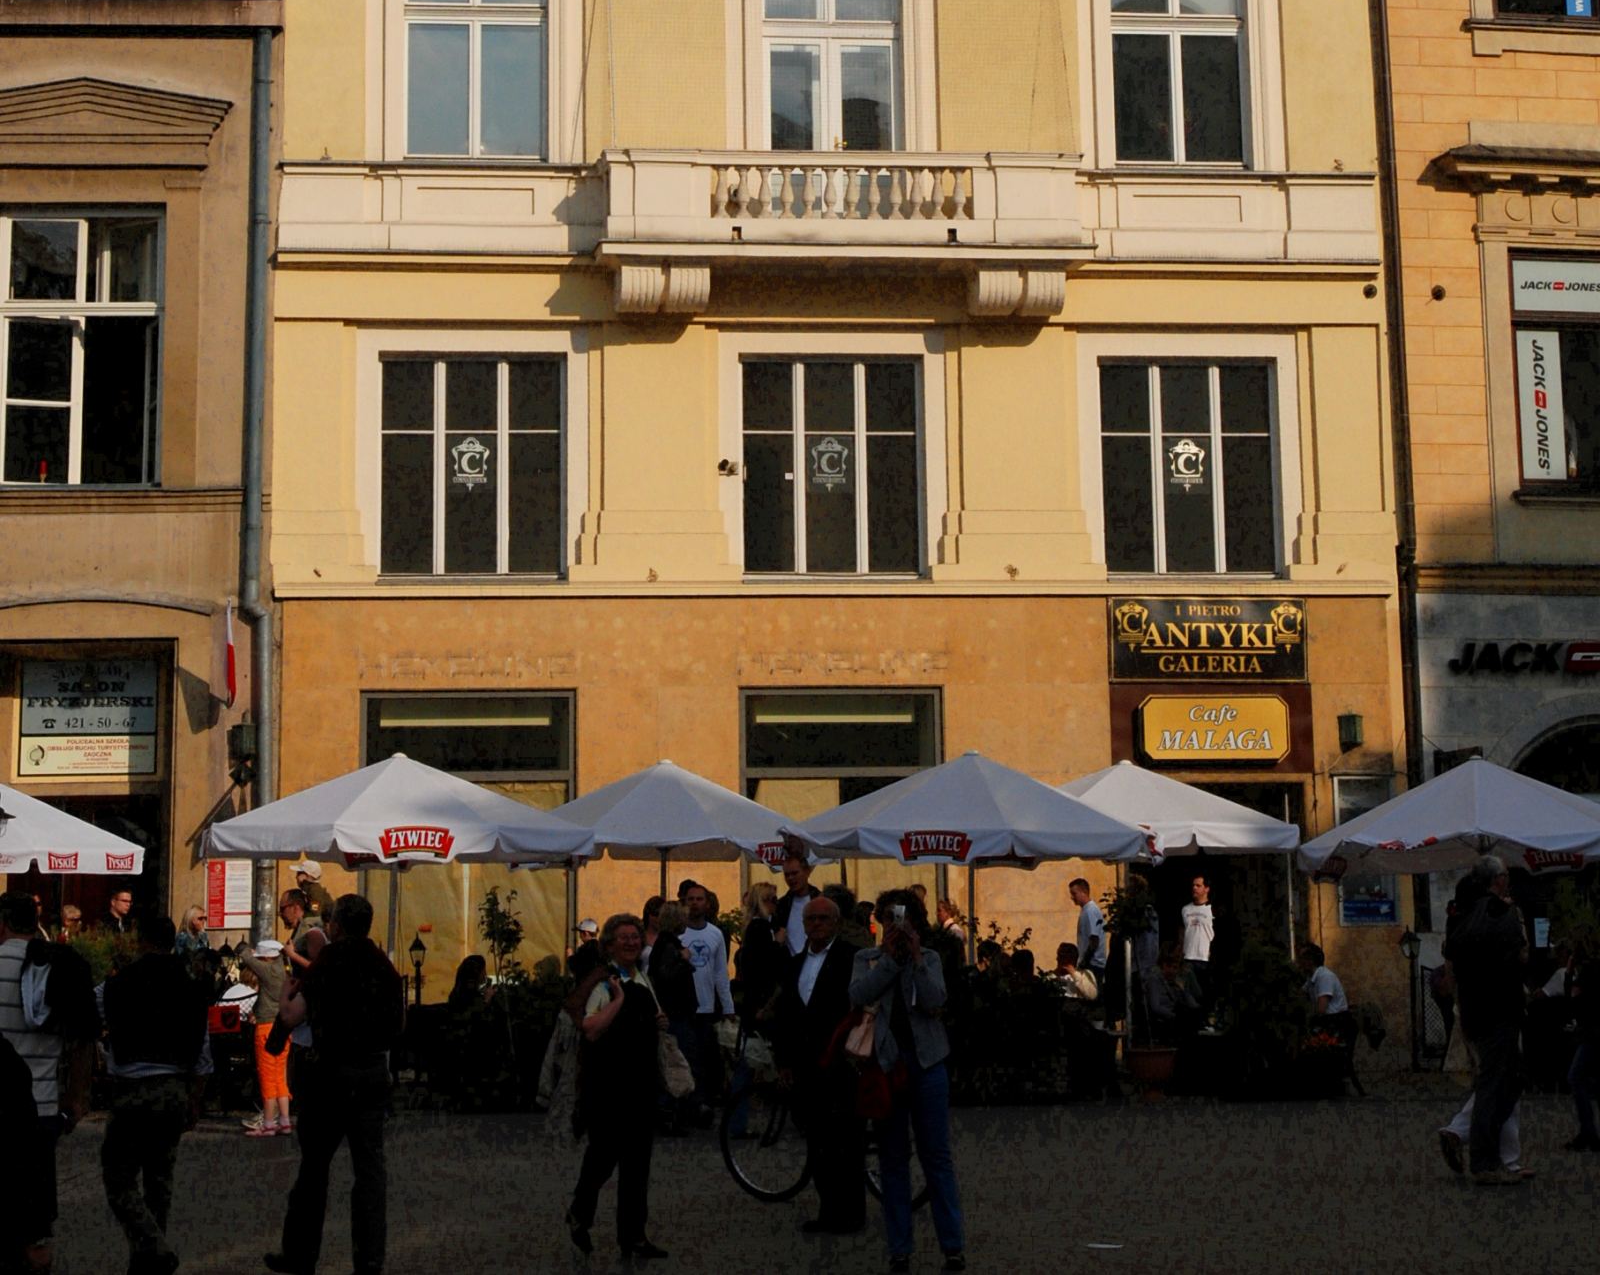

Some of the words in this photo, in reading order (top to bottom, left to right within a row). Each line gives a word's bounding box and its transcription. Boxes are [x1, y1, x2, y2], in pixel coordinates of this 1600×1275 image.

[1520, 281, 1552, 290] JACK
[1532, 339, 1546, 389] JACK
[1535, 409, 1550, 469] JONES
[1188, 605, 1241, 616] PIETRO
[1141, 622, 1276, 648] ANTYKI
[1158, 655, 1263, 673] GALERIA
[1449, 642, 1564, 673] JACK
[58, 681, 126, 693] SAON
[27, 696, 154, 707] FRYZJERSKI
[64, 718, 84, 728] 421
[97, 718, 111, 728] 50
[122, 717, 136, 727] 67
[1189, 705, 1237, 725] Cafe
[1158, 729, 1273, 751] MALAGA
[391, 829, 444, 849] ŻYWIEC
[910, 833, 962, 852] ŻYWIEC
[50, 856, 76, 868] TYSKIE
[108, 856, 133, 869] TYSKIE
